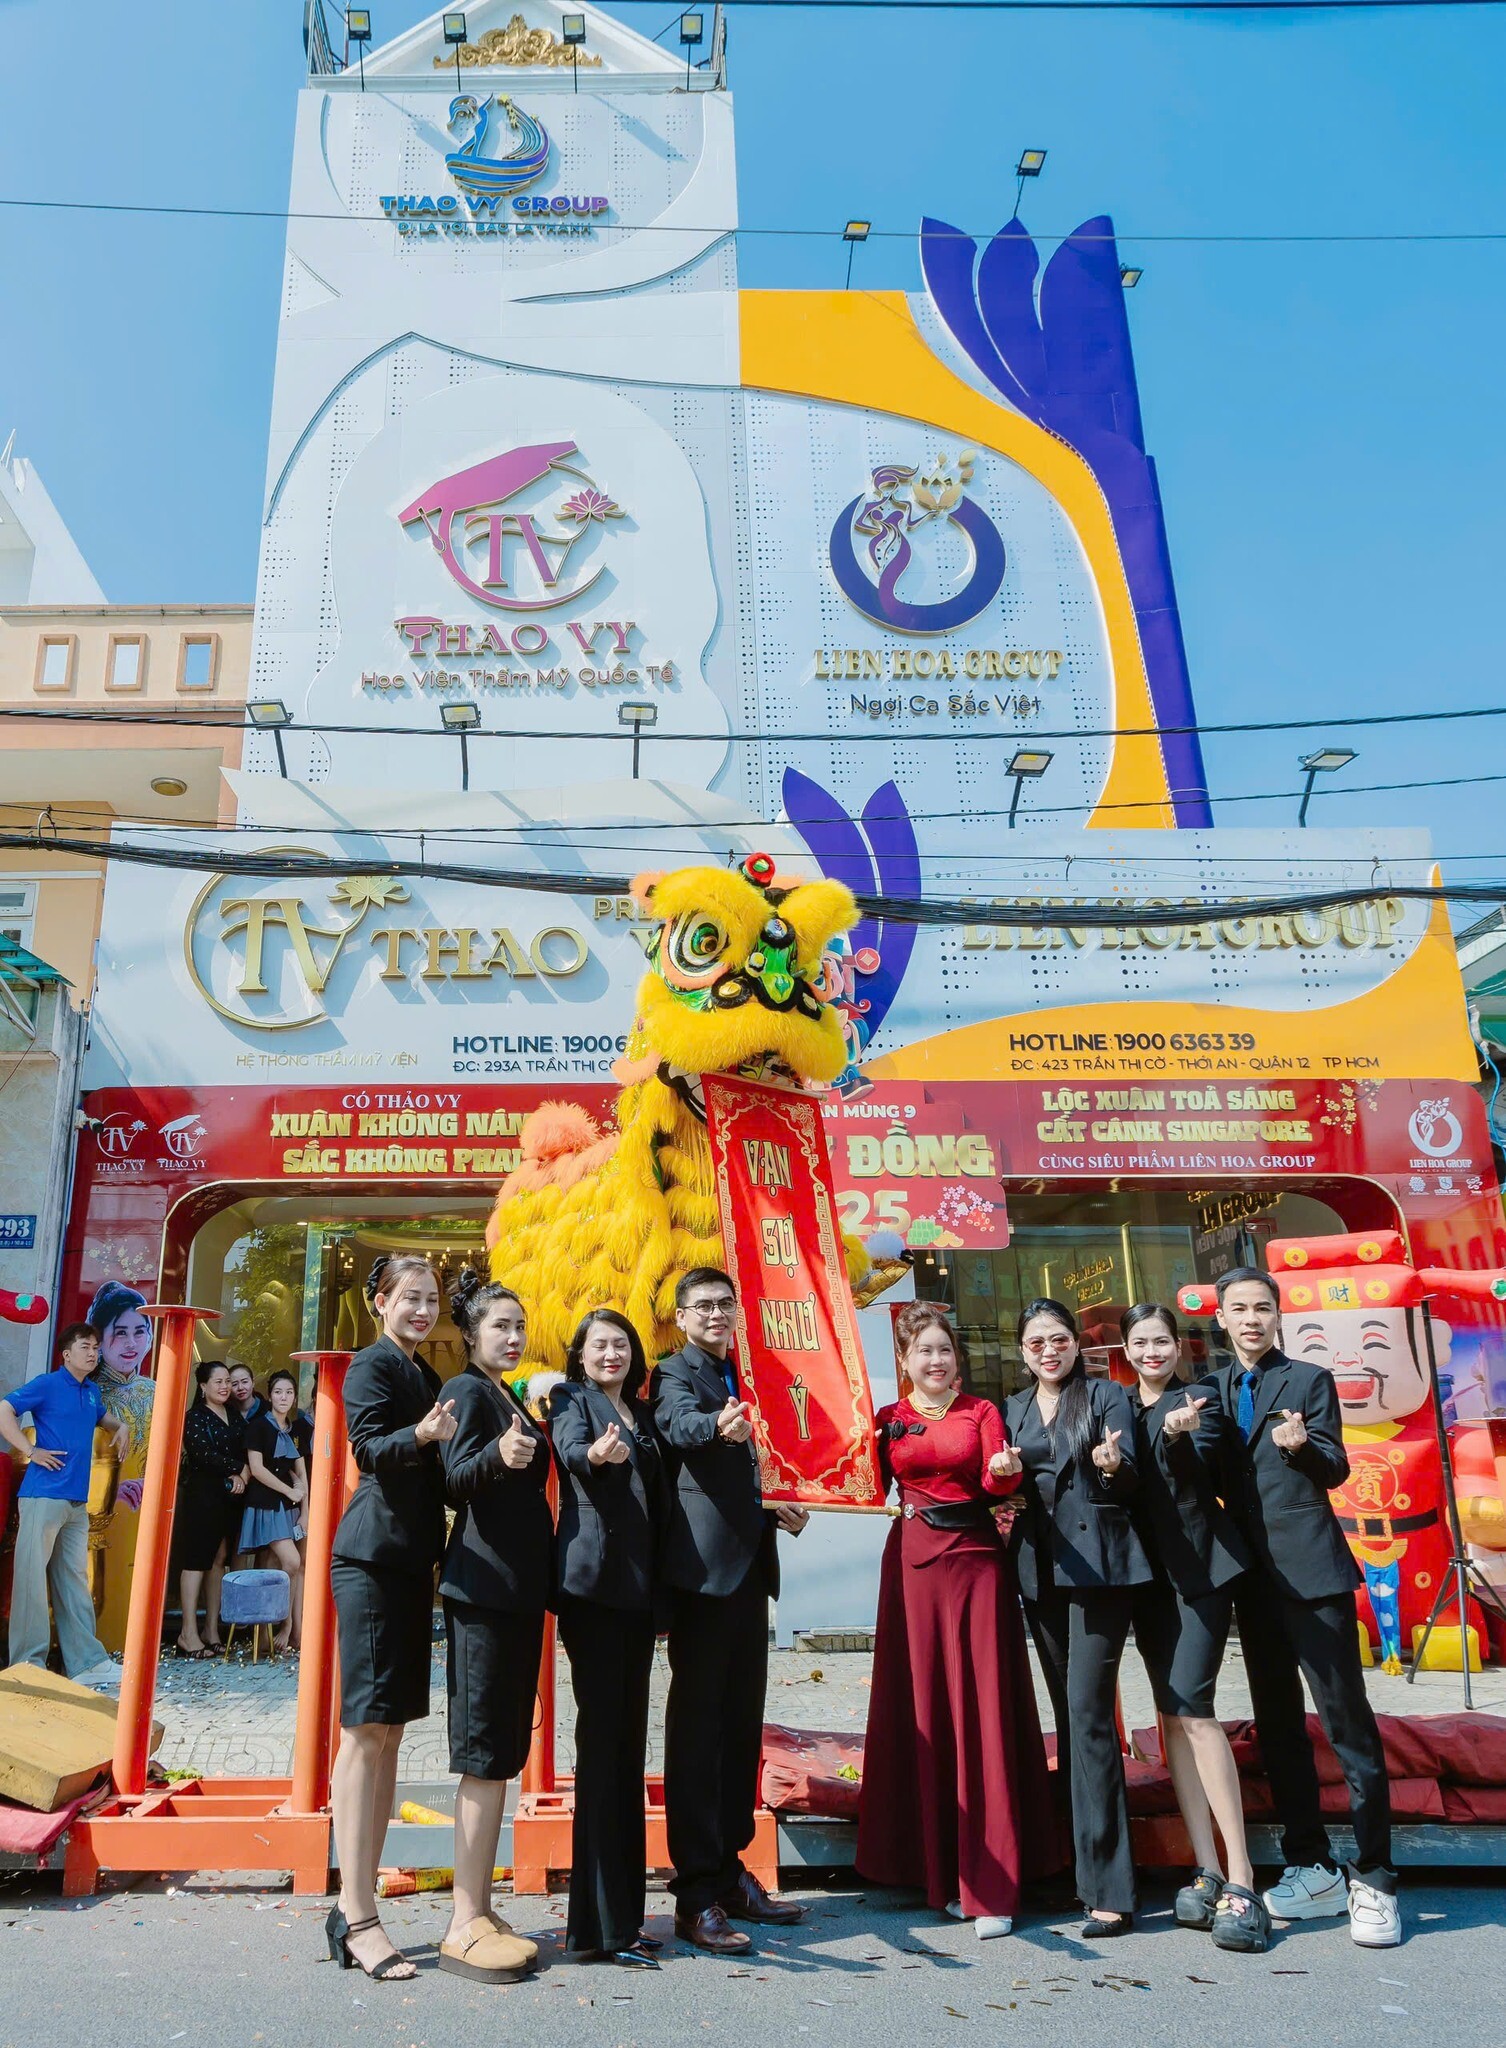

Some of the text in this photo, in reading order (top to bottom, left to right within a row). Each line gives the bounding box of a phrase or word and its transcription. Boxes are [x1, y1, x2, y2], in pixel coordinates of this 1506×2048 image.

[379, 195, 610, 216] THAO VY GROUP
[394, 616, 636, 656] THAO VY
[814, 649, 1065, 678] LIEN HOA GROUP
[360, 659, 675, 693] Học Viện Thẩm Mỹ Quốc Tế
[909, 694, 939, 713] Ca
[948, 690, 991, 713] Sắc
[994, 693, 1042, 716] Việt
[370, 926, 589, 979] THAO
[562, 1035, 613, 1054] 1900
[1114, 1033, 1165, 1052] 1900
[236, 1052, 255, 1068] HỆ
[259, 1050, 309, 1067] THỐNG
[359, 1051, 383, 1067] MỸ
[388, 1051, 418, 1068] VIỆN
[453, 1060, 480, 1072] ĐC:
[484, 1060, 522, 1072] 293A
[526, 1056, 568, 1072] TRẦN
[572, 1059, 595, 1073] THỊ
[1041, 1058, 1069, 1071] 423
[1073, 1054, 1115, 1071] TRẦN
[1118, 1057, 1142, 1073] THỊ
[1216, 1057, 1238, 1071] AN
[1249, 1055, 1293, 1074] QUẬN
[1295, 1057, 1310, 1070] 12
[1322, 1056, 1342, 1070] TP
[1346, 1057, 1380, 1070] HCM
[342, 1090, 462, 1109] CÓ THẢO VY
[844, 1101, 900, 1118] MÙNG
[904, 1104, 917, 1118] 9
[1042, 1085, 1297, 1115] LỘC XUÂN TOẢ SÁNG
[270, 1108, 352, 1138] XUÂN
[358, 1108, 459, 1138] KHÔNG
[1036, 1111, 1088, 1143] CẤT
[1166, 1119, 1314, 1143] SINGAPORE
[345, 1143, 448, 1174] KHÔNG
[848, 1120, 996, 1177] ĐỒNG
[95, 1162, 145, 1171] THAO VY
[192, 1159, 207, 1168] VY
[1038, 1150, 1316, 1169] CÙNG SIÊU PHẨM LIÊN HOA GROUP
[1428, 1159, 1445, 1168] HOA
[1445, 1159, 1473, 1168] GROUP
[742, 1138, 821, 1440] VẠN SỰ NHƯ Ý
[1328, 1283, 1349, 1304] 财
